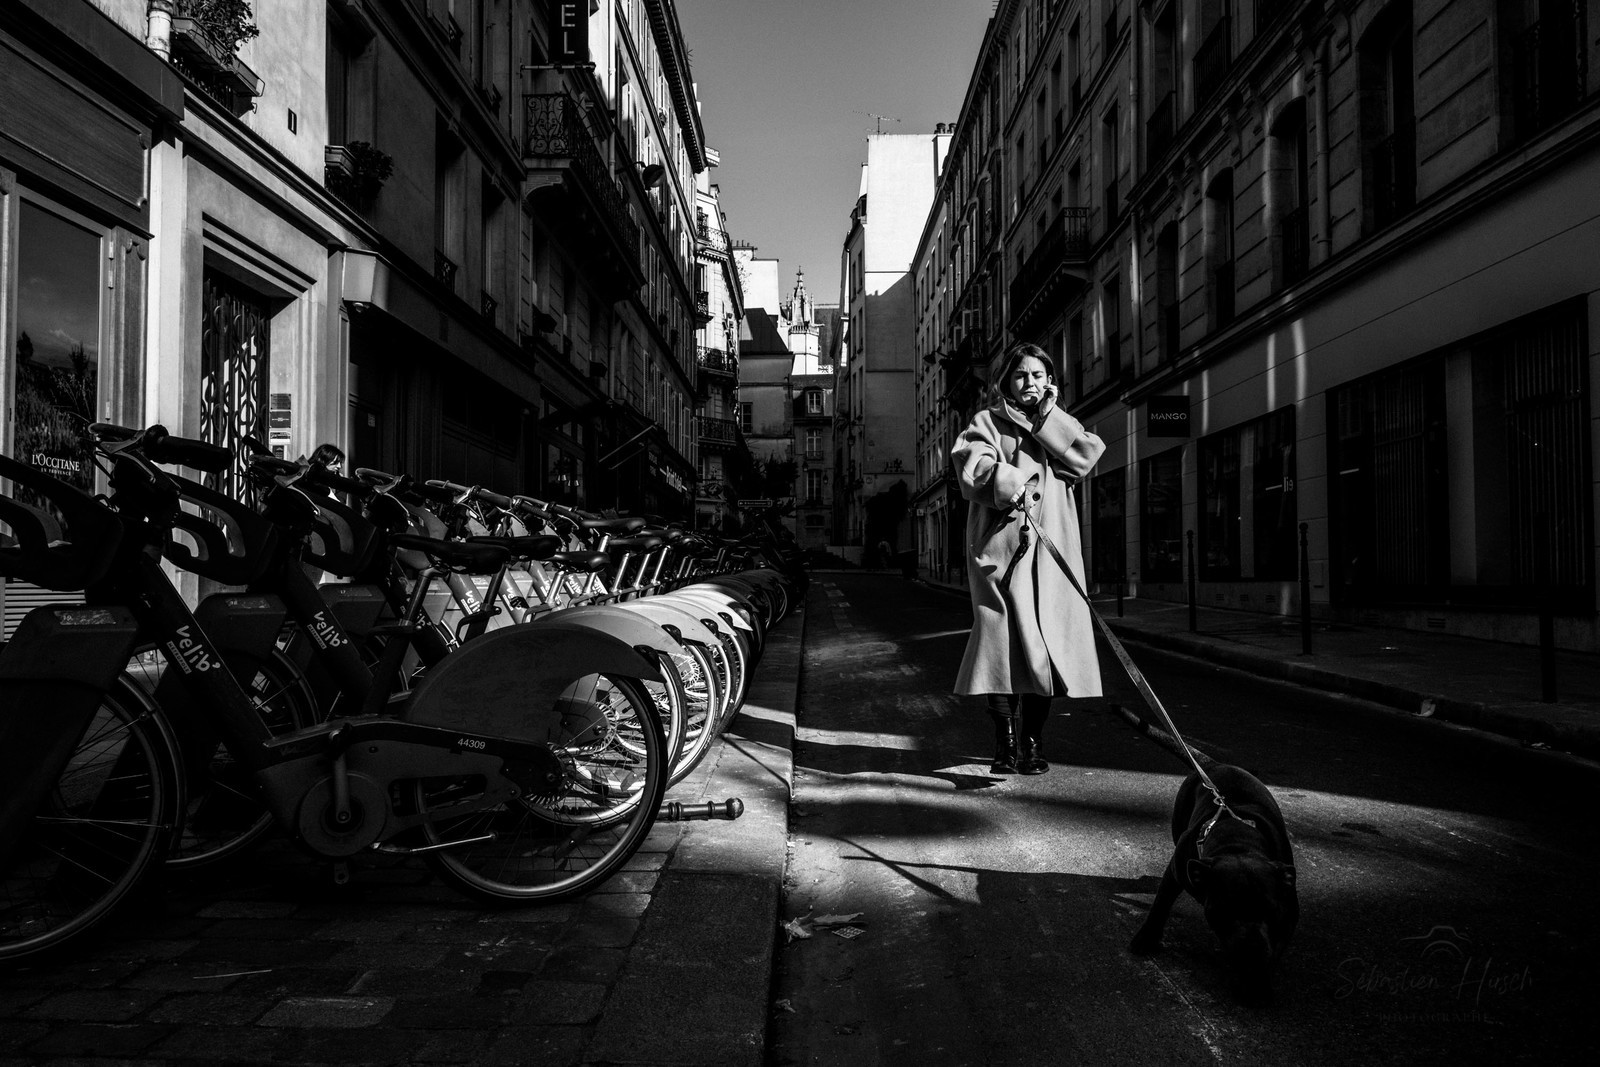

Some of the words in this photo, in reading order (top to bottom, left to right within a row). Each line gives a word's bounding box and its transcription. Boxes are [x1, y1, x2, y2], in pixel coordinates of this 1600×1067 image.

[561, 4, 576, 54] EL
[1150, 412, 1187, 420] MANGO
[31, 452, 80, 471] L'OCCITANE
[457, 738, 486, 750] 44309
